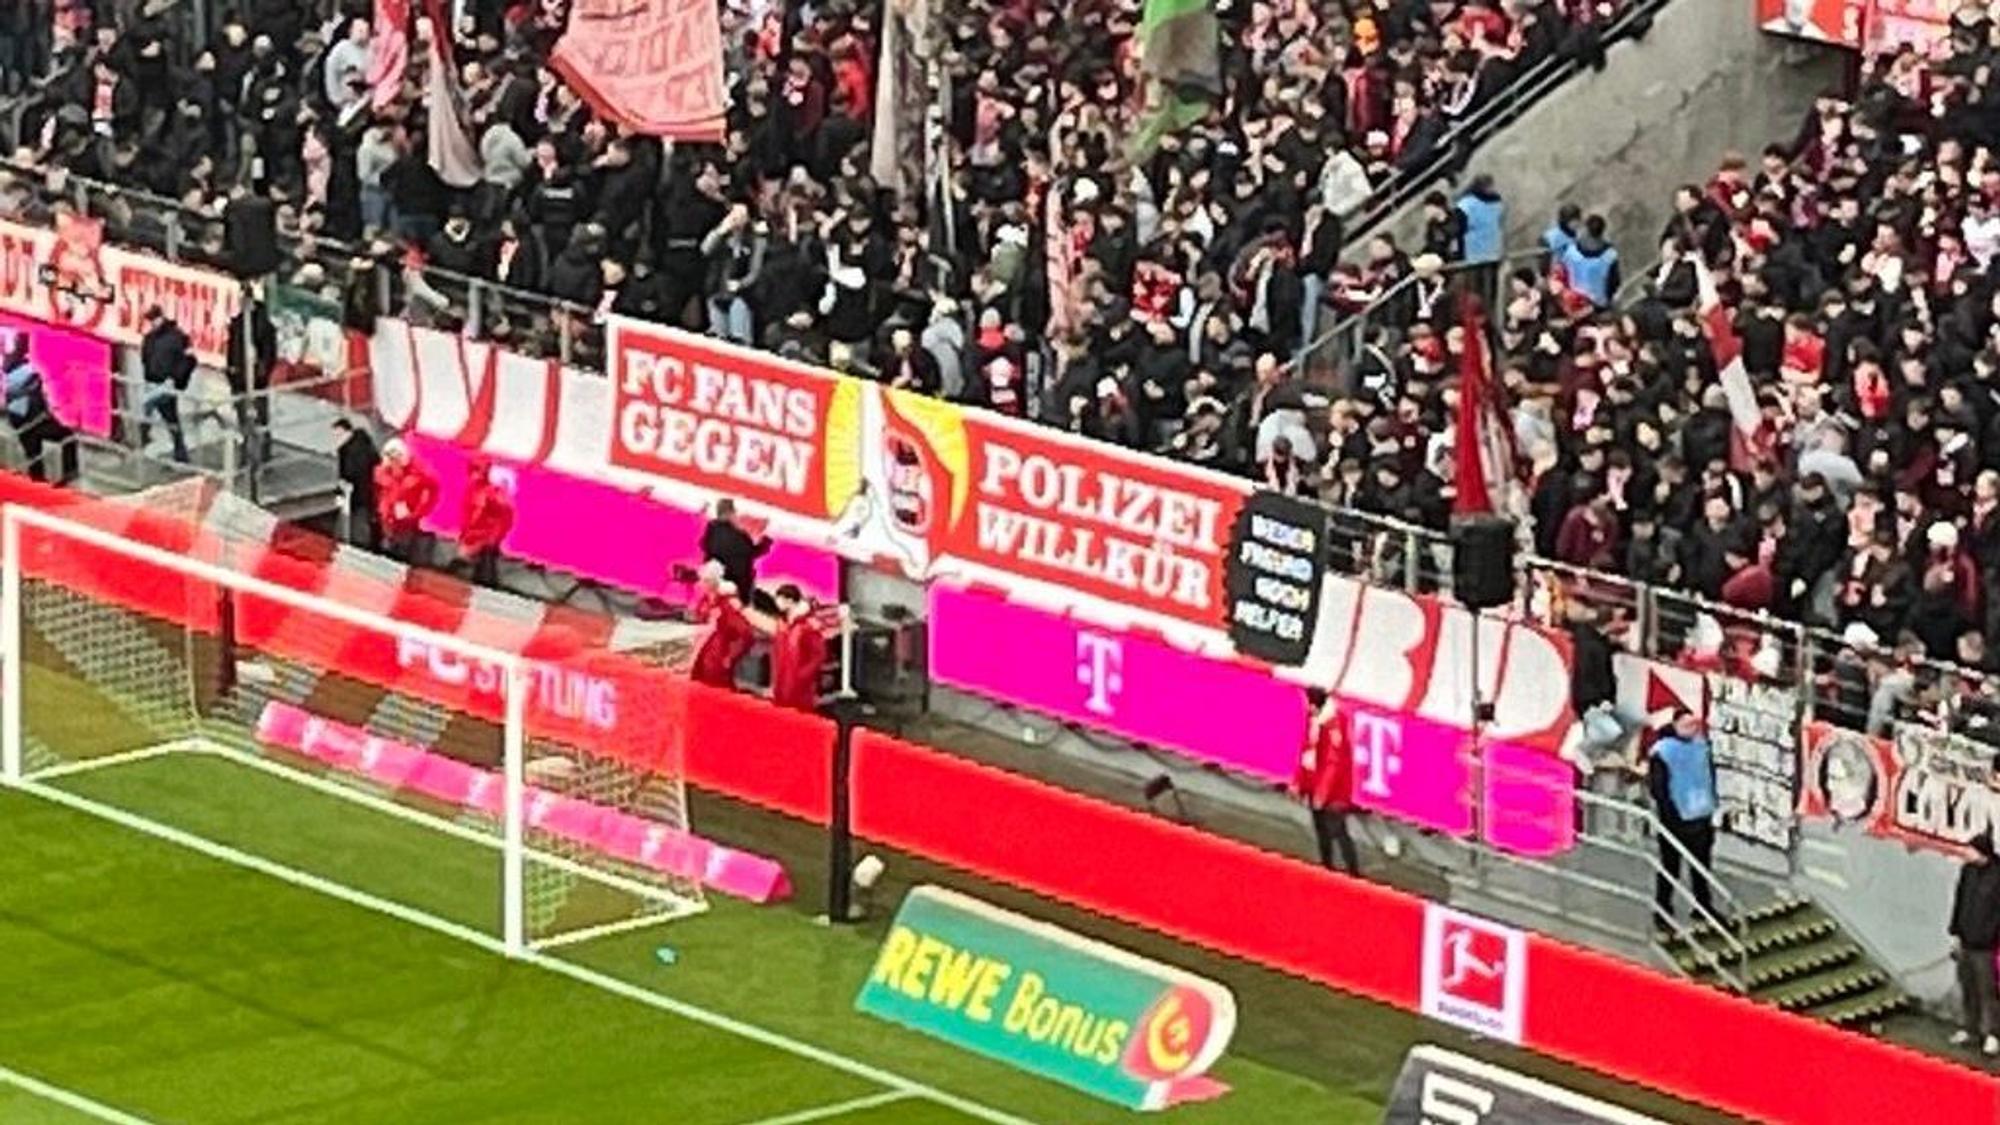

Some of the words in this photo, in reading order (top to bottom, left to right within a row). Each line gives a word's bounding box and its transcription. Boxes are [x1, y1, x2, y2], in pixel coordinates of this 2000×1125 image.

[621, 348, 686, 404] FC
[692, 362, 817, 437] FANS
[619, 399, 816, 496] GEGEN
[978, 441, 1222, 555] POLIZEI
[975, 501, 1212, 609] WILLKÜR
[1076, 630, 1123, 716] T
[1353, 711, 1402, 797] T
[874, 925, 1013, 1021] REWE
[1003, 972, 1129, 1065] Bonus
